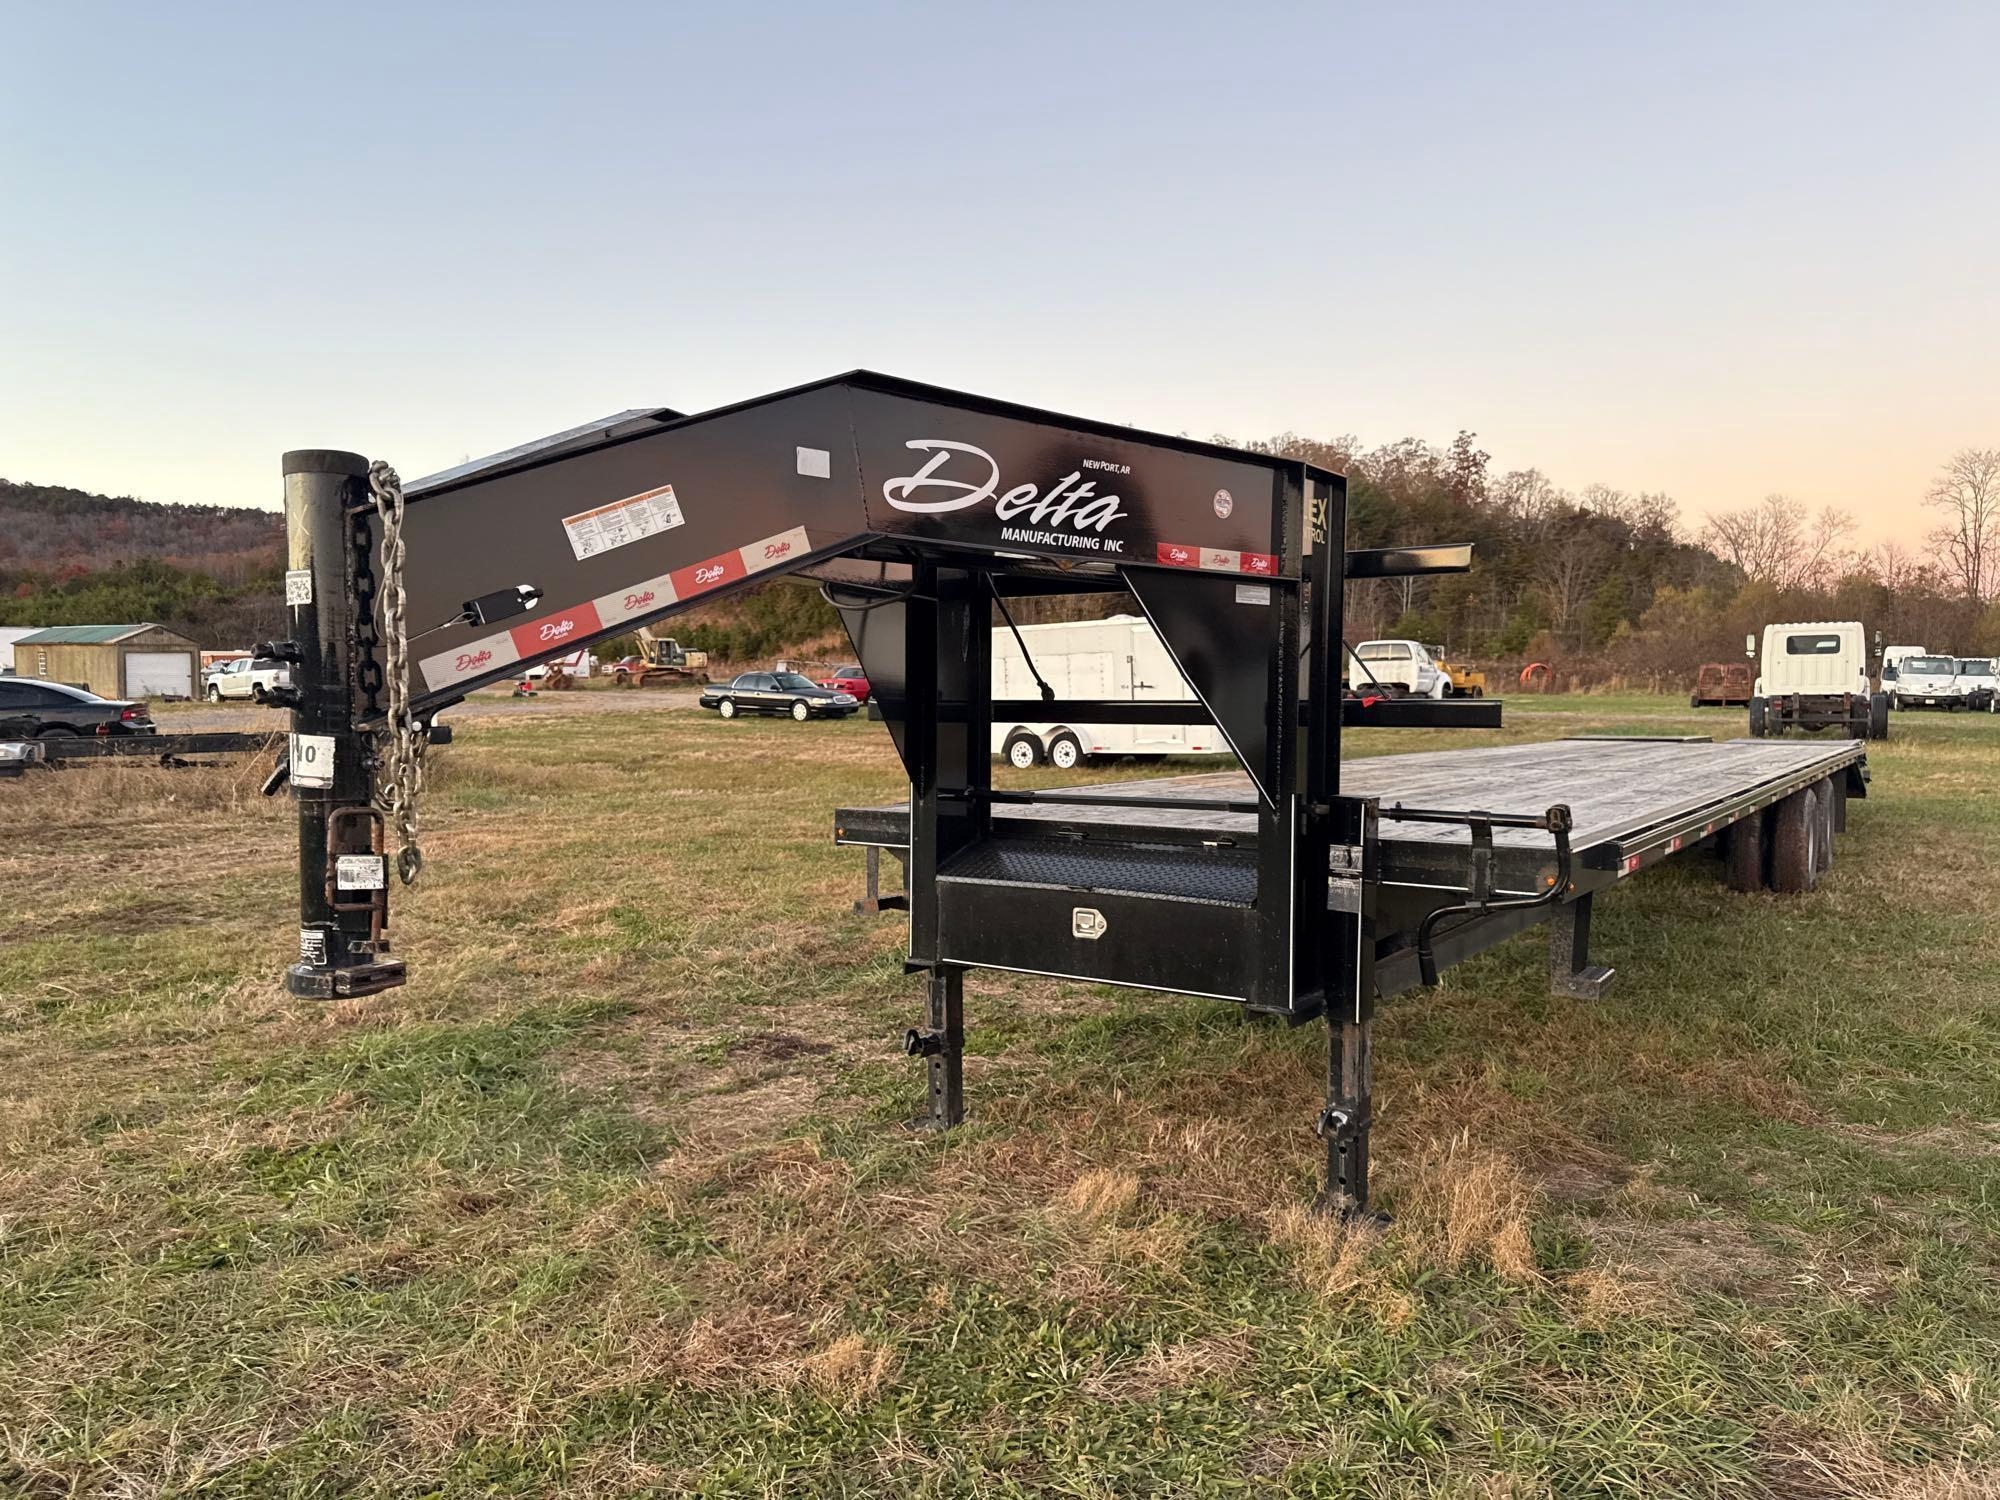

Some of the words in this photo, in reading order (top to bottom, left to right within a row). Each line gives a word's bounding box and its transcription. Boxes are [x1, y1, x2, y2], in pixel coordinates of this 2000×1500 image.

[1120, 465, 1131, 475] AR
[883, 439, 1128, 532] Delta
[764, 541, 791, 559] Delta
[1001, 527, 1100, 551] MANUFACTURING
[1104, 538, 1124, 553] INC
[695, 564, 725, 584] Delta
[624, 591, 655, 610] Delta
[539, 619, 574, 641] Delta
[455, 650, 492, 672] Delta
